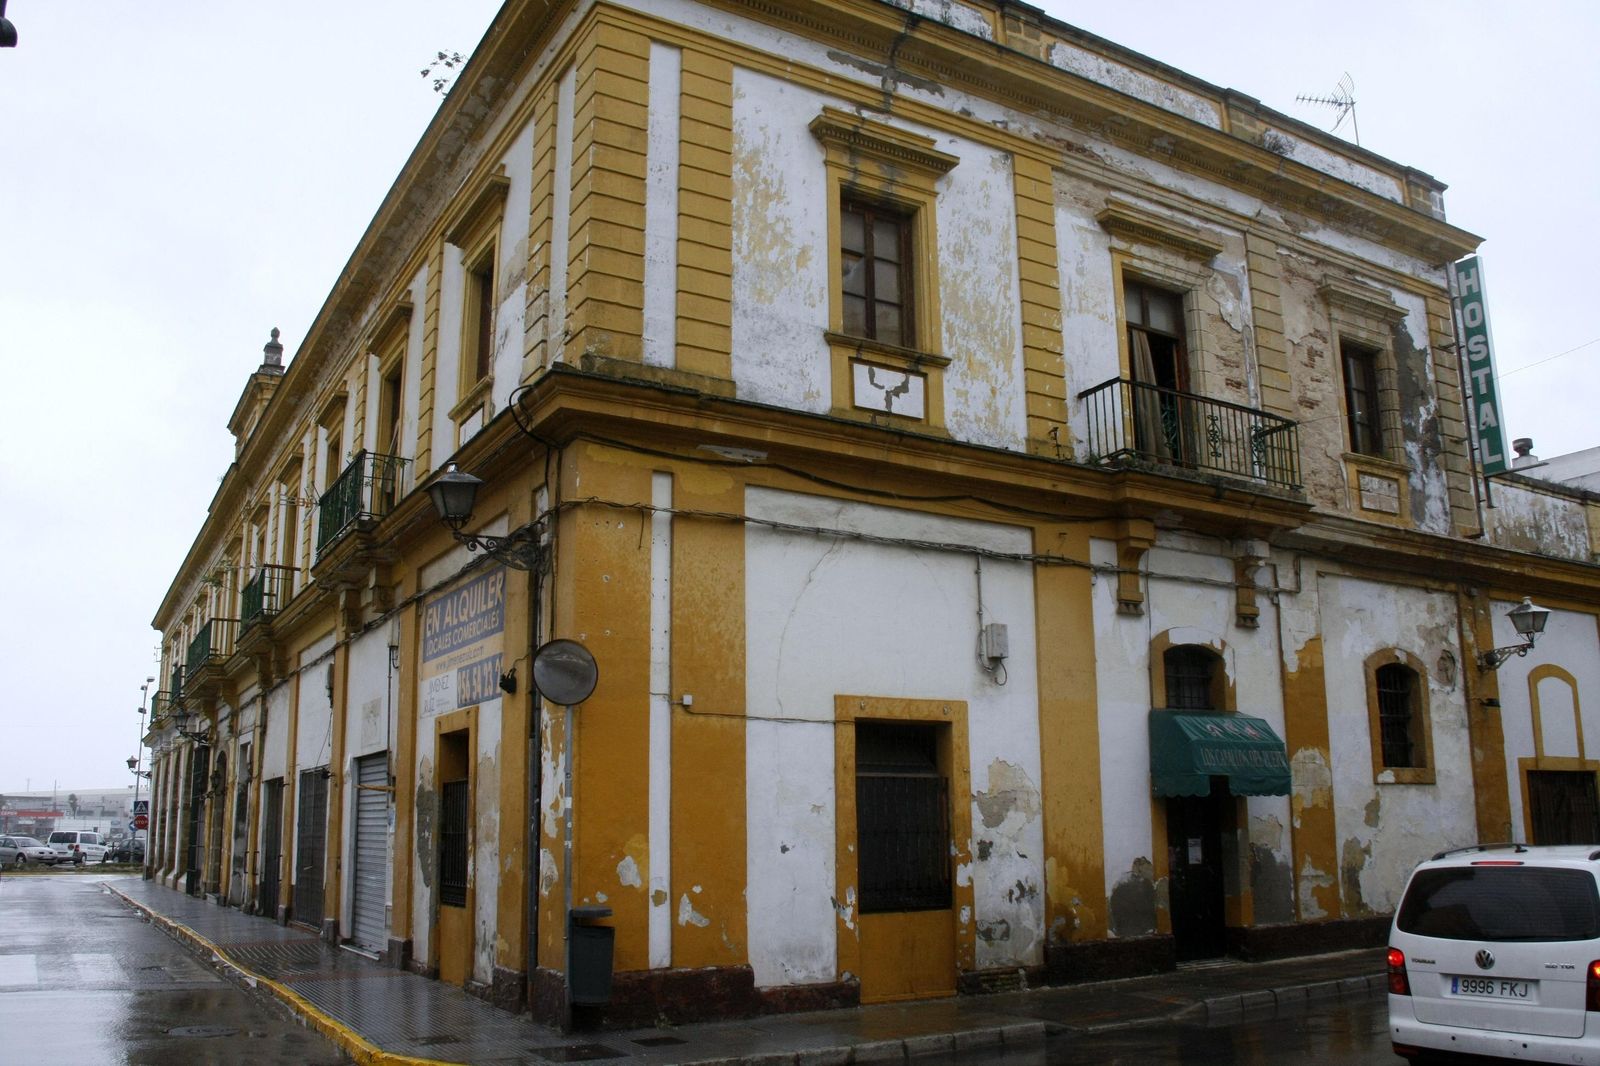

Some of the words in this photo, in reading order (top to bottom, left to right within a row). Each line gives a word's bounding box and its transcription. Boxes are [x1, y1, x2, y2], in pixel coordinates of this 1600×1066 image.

[1457, 266, 1502, 465] HOSTAL
[425, 606, 441, 638] EN
[443, 571, 504, 630] ALQUILER
[452, 609, 500, 645] COMERCIALES
[1461, 978, 1494, 995] 9996
[1500, 981, 1529, 998] FKJ
